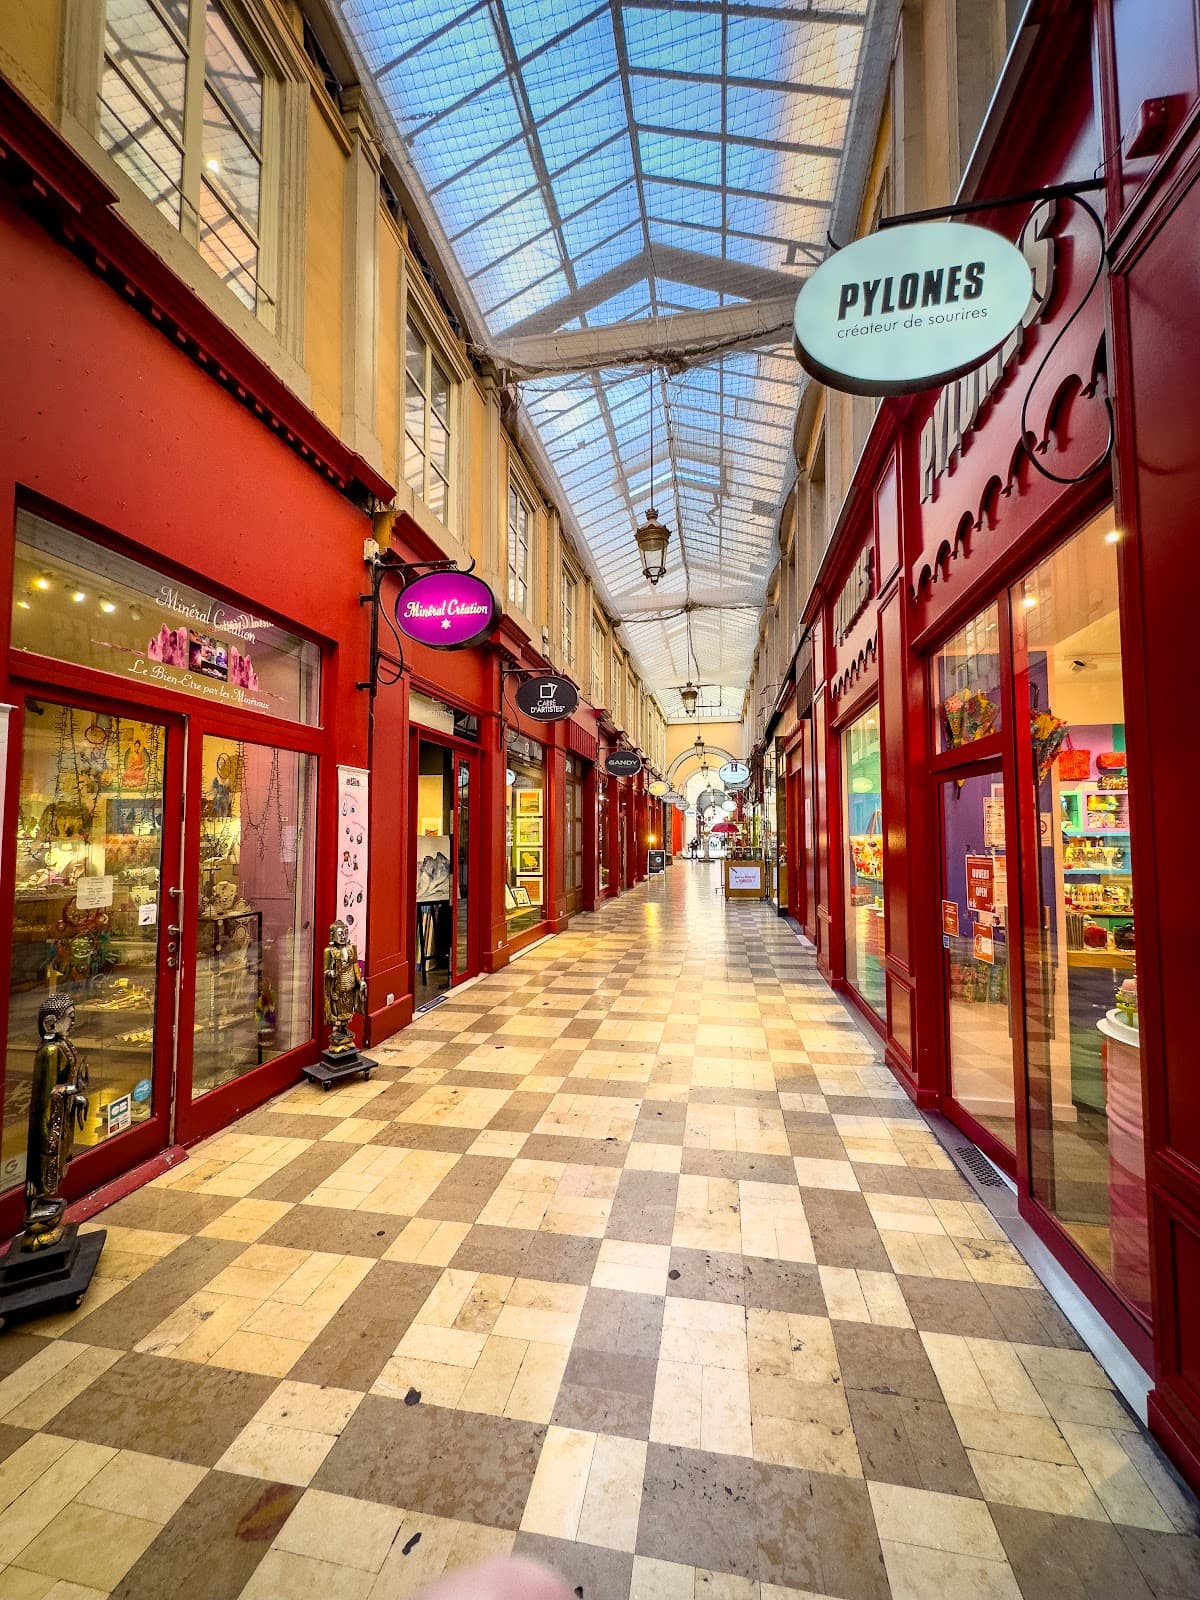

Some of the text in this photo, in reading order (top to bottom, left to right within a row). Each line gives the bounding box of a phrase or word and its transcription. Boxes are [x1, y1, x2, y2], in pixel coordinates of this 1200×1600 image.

[836, 260, 987, 321] PYLONES
[836, 306, 988, 339] créateur de sourires
[156, 585, 213, 624] Minéral
[213, 609, 257, 645] Création
[404, 599, 489, 618] Minéral Création
[128, 660, 147, 676] Le
[202, 685, 218, 698] par
[219, 685, 230, 699] les
[230, 688, 270, 710] Minéraux
[975, 887, 988, 898] OPEN
